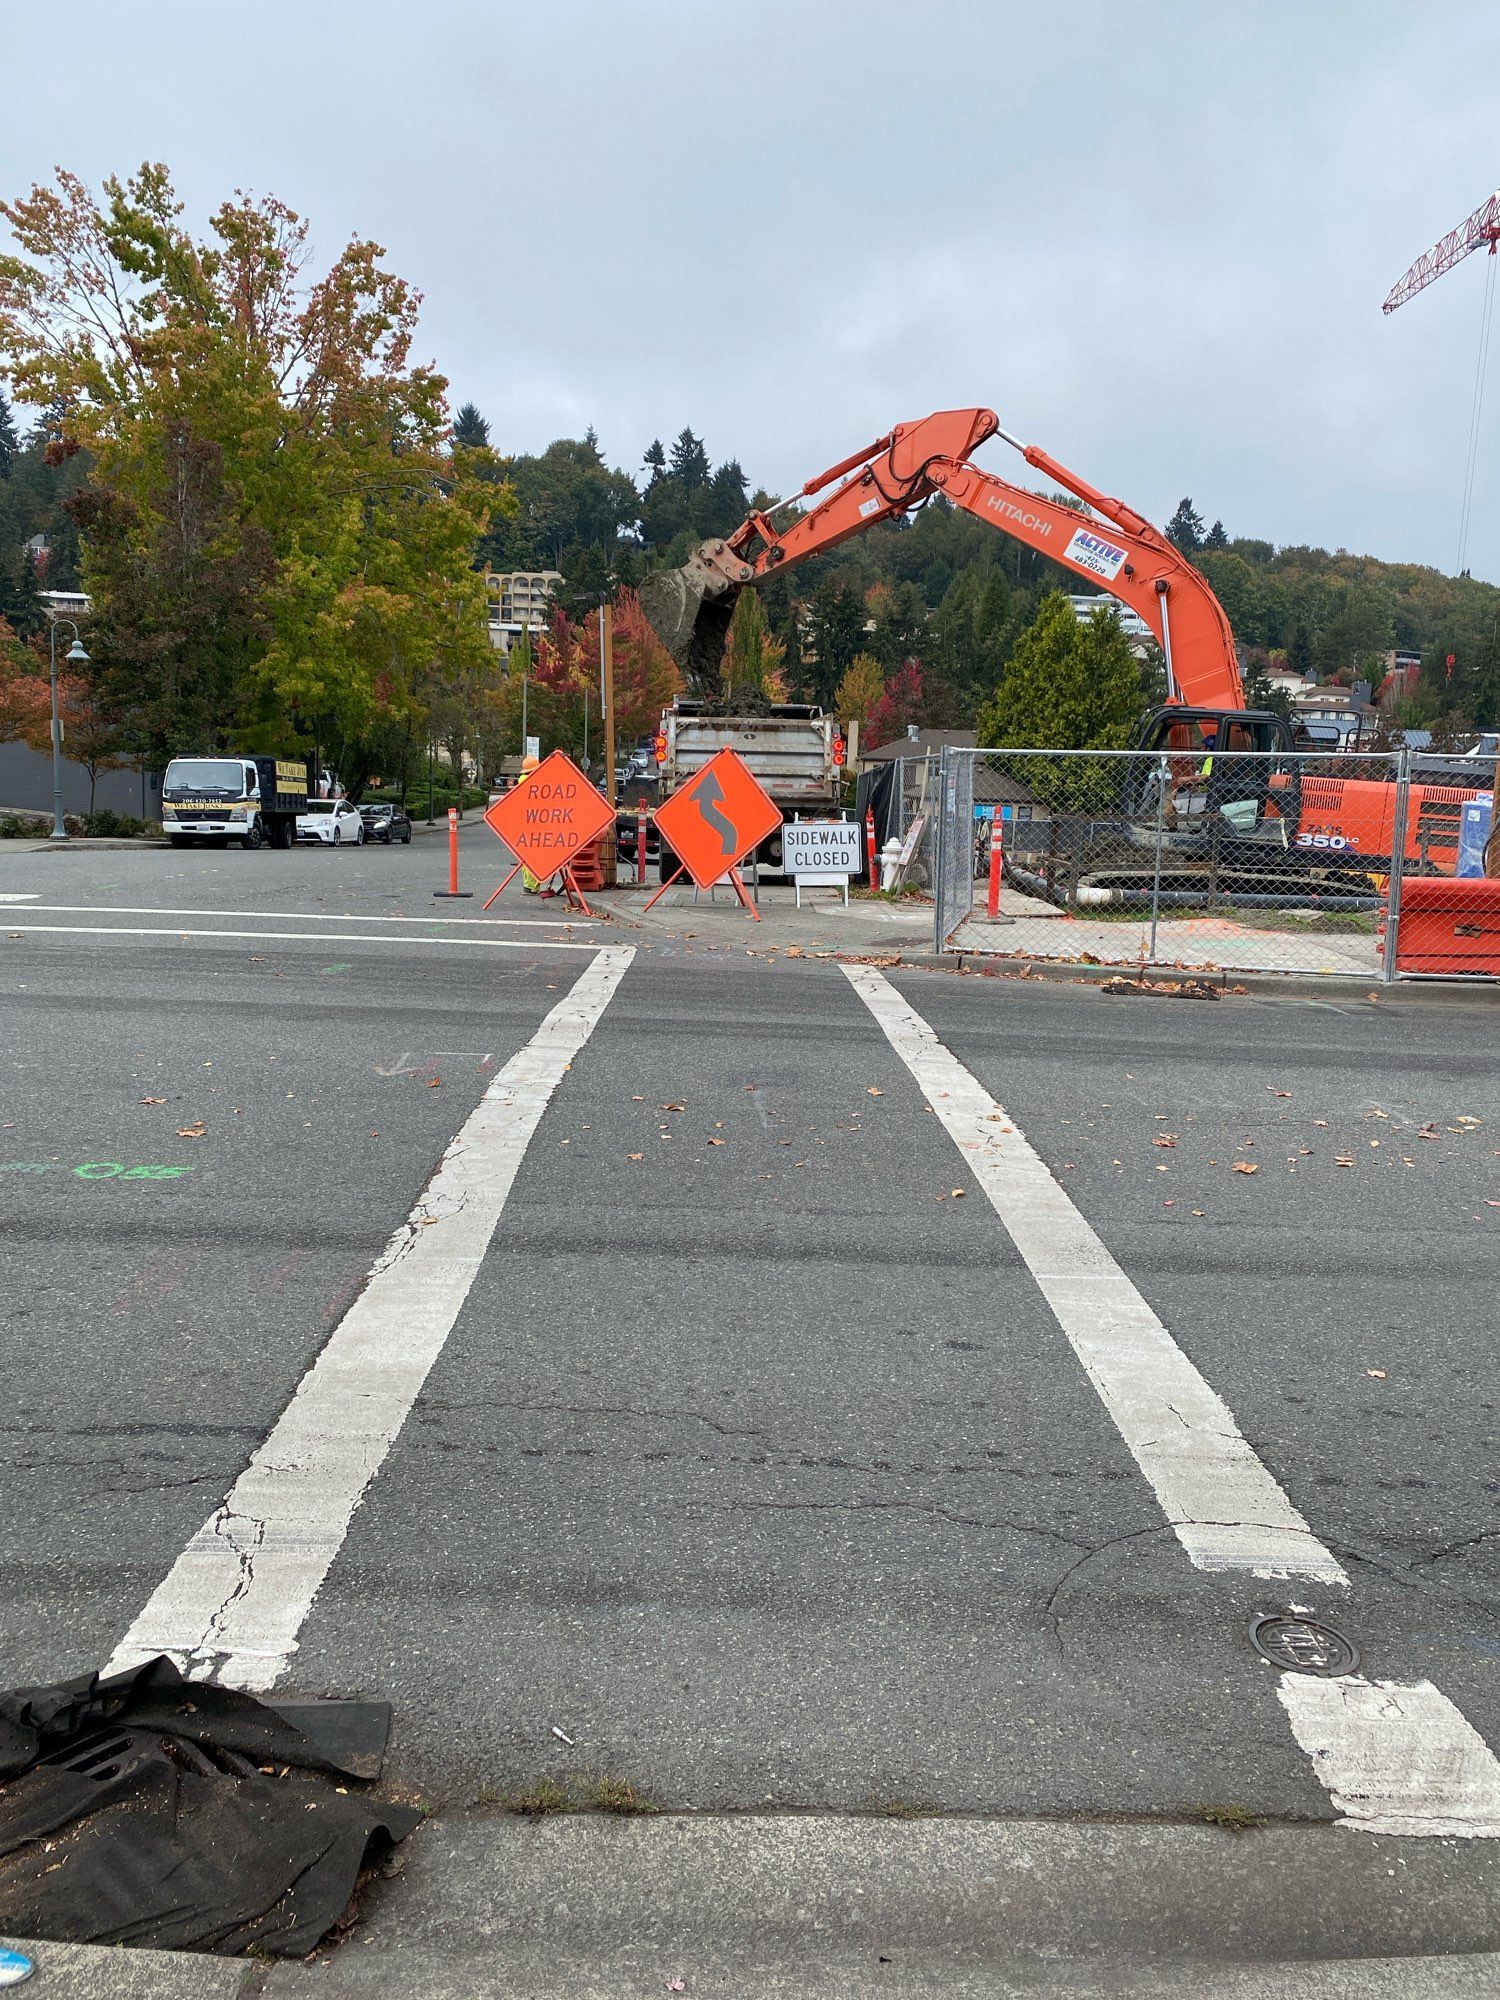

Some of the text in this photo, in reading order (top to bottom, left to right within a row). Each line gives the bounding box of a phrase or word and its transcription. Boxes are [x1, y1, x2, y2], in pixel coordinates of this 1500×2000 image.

[988, 496, 1052, 536] HITACHI
[1075, 532, 1125, 562] ACTIVE
[1074, 555, 1106, 574] 483-0229
[527, 783, 577, 800] ROAD
[525, 808, 574, 824] WORK
[515, 831, 579, 849] AHEAD
[786, 830, 857, 846] SIDEWALK
[794, 851, 850, 867] CLOSED
